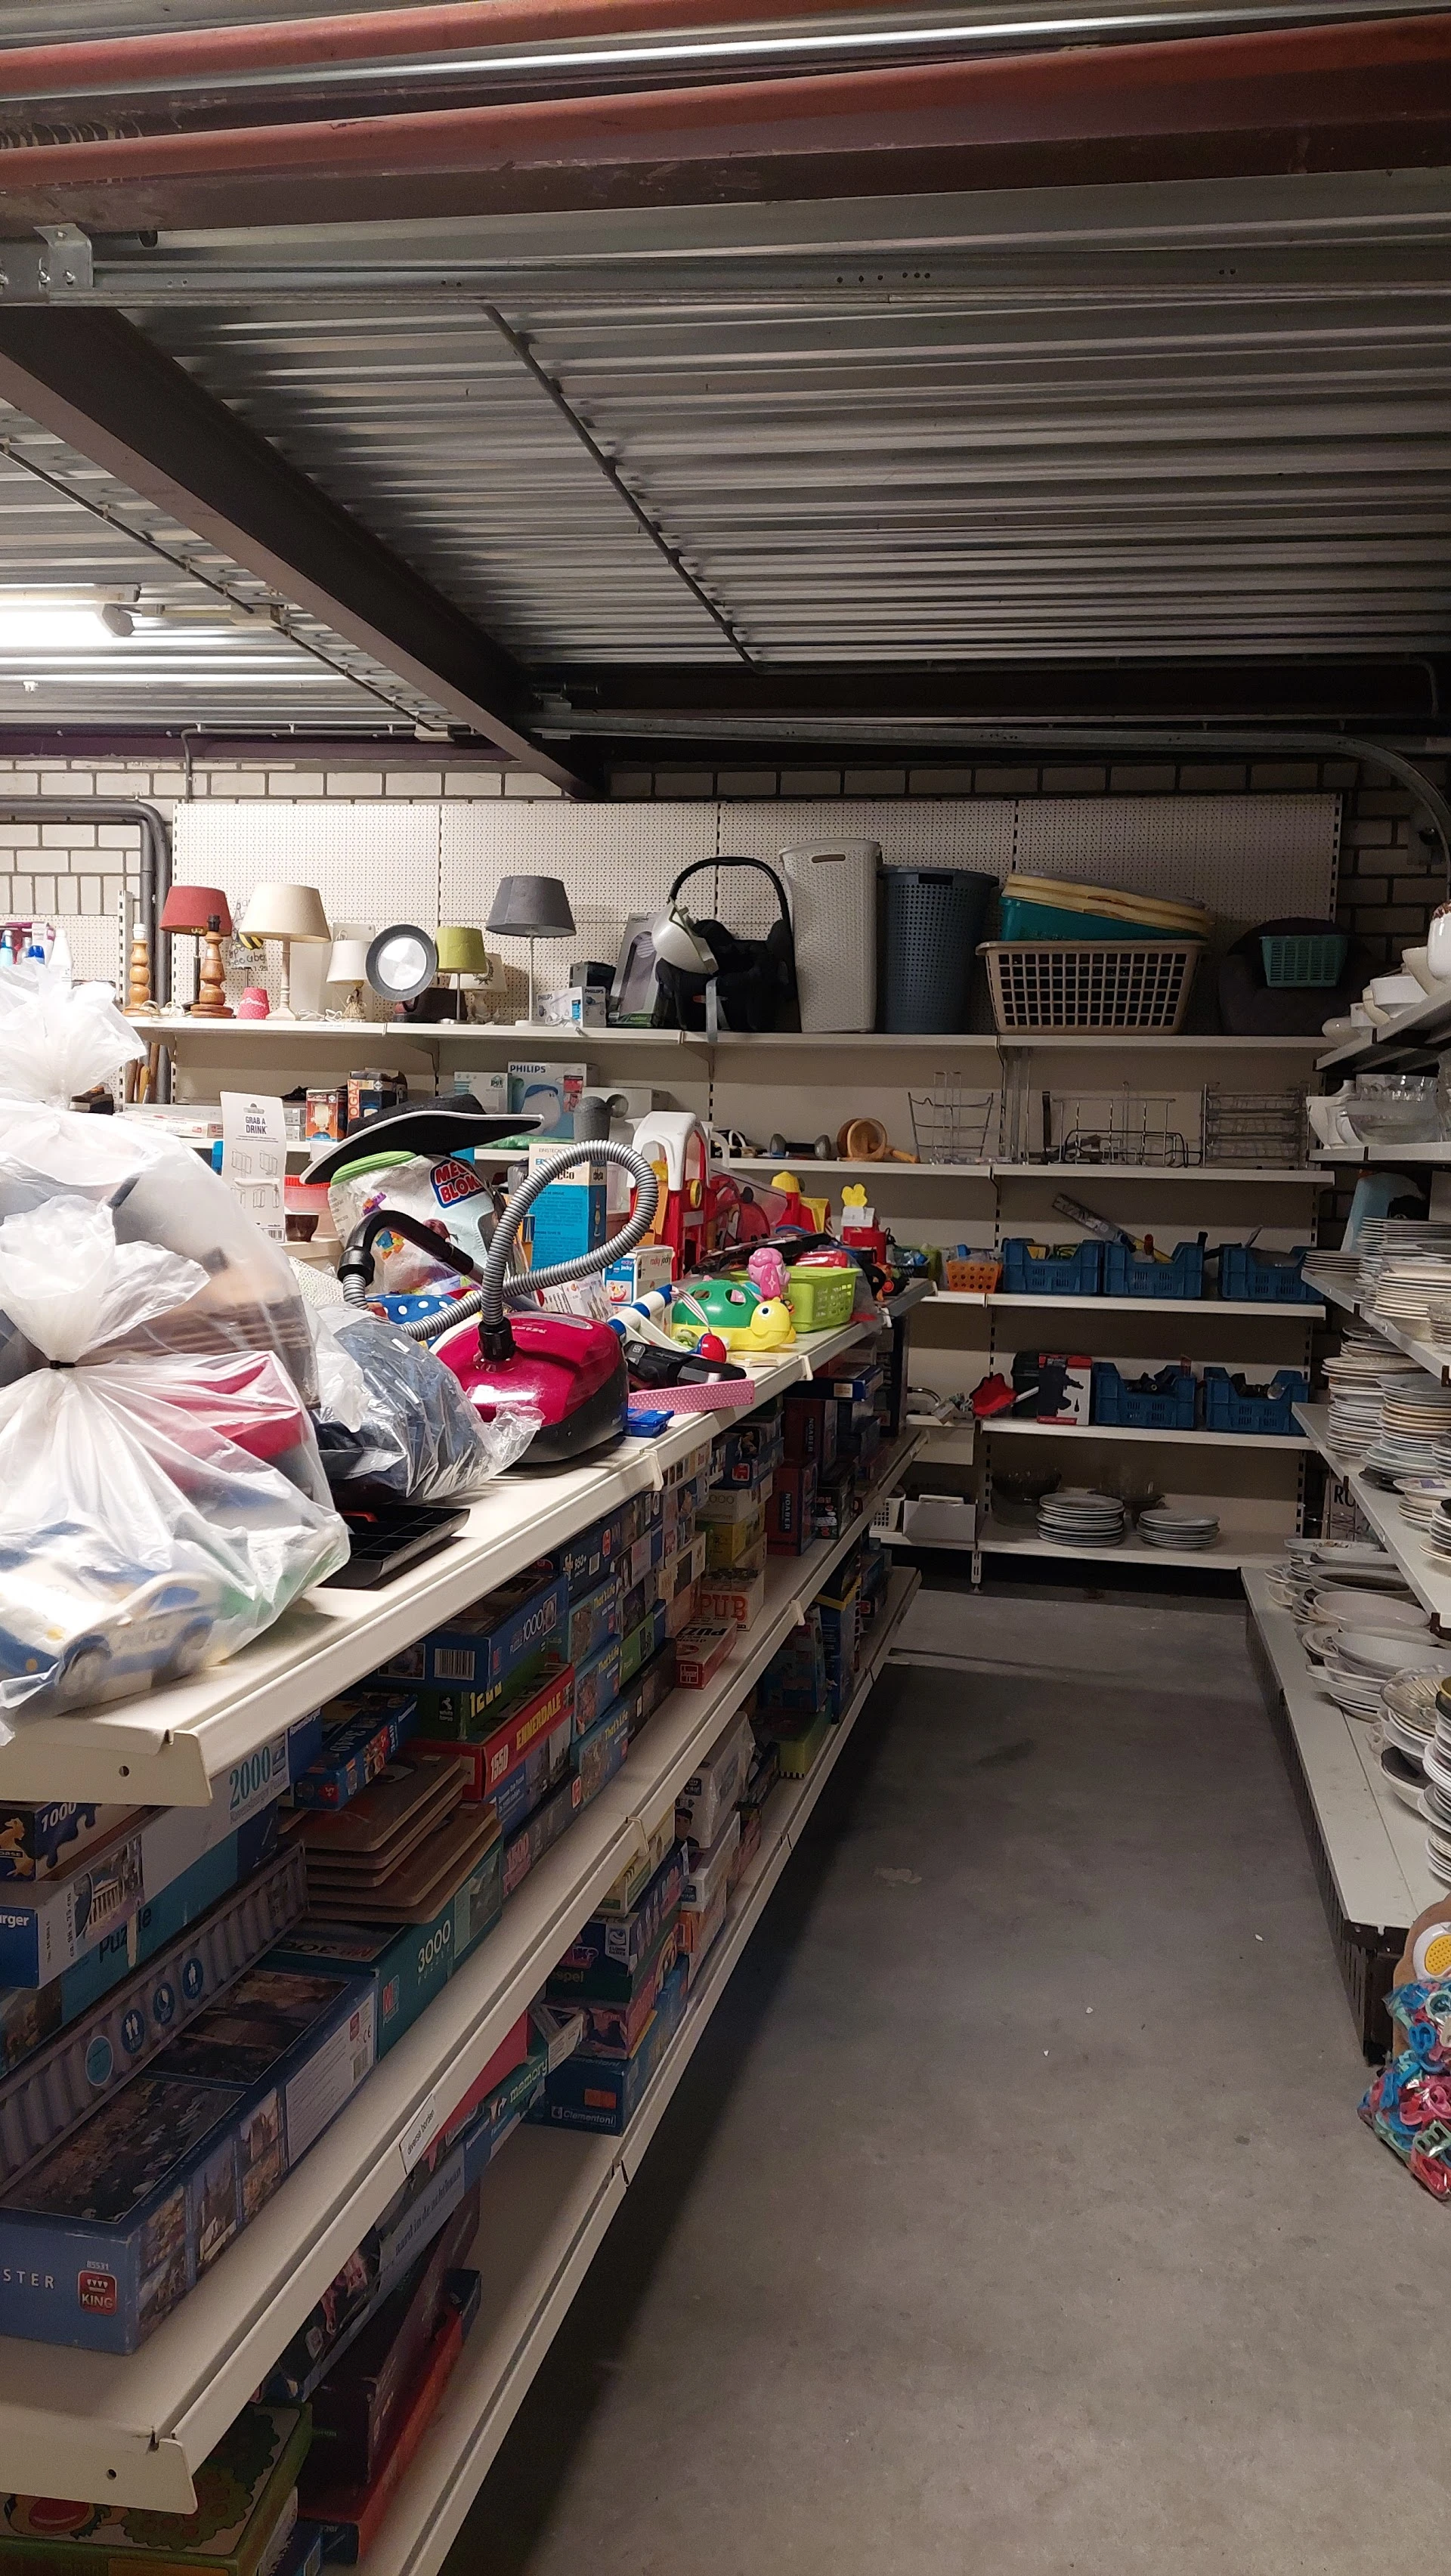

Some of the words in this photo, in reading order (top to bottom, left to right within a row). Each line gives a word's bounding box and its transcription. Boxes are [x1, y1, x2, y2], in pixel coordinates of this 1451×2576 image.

[510, 1064, 546, 1073] PHILIPS
[348, 1081, 359, 1120] OGAZ
[246, 1116, 261, 1124] GRAB
[246, 1124, 267, 1134] DRINK
[522, 1607, 543, 1643] 1000
[229, 1746, 271, 1811] 2000
[490, 1743, 509, 1783] 1550
[99, 1907, 151, 1964] Puzle
[418, 1919, 451, 1974] 3000
[509, 2057, 549, 2103] memory
[564, 2109, 614, 2126] Clementoni
[2, 2268, 55, 2290] STER
[81, 2293, 114, 2309] KING
